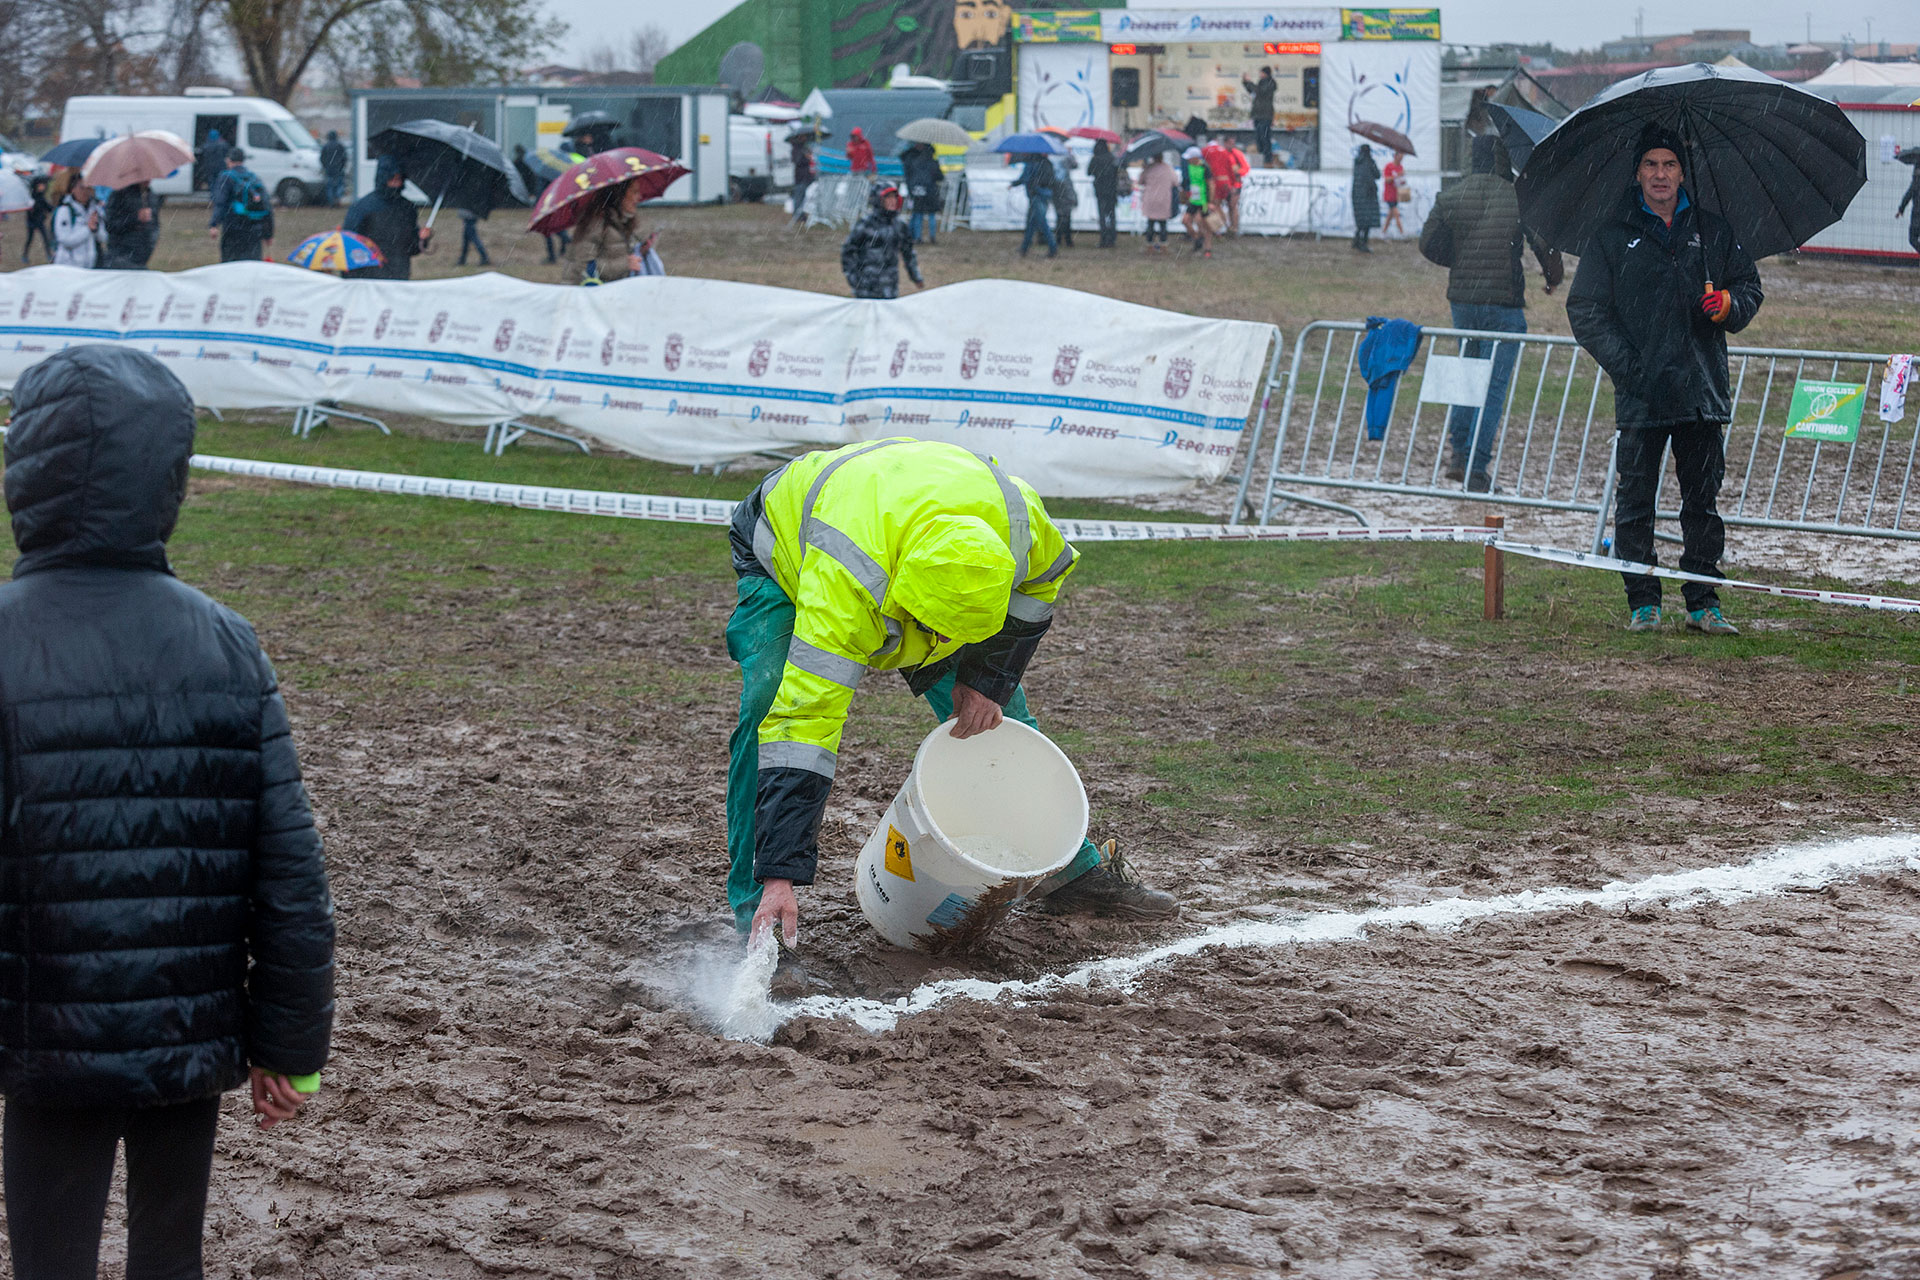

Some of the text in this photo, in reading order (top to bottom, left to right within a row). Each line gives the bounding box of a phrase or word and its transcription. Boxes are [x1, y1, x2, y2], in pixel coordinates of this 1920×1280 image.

[986, 352, 1033, 365] Diputación
[1085, 358, 1141, 376] Diputación
[788, 365, 822, 378] Segovia
[984, 364, 1031, 379] de Segovia
[1081, 372, 1138, 389] de Segovia
[1198, 388, 1250, 405] de Segovia
[750, 405, 810, 426] DEPORTES
[883, 405, 931, 425] DEPORTES
[955, 409, 1015, 430] DEPORTES
[1045, 415, 1119, 440] DEPORTES
